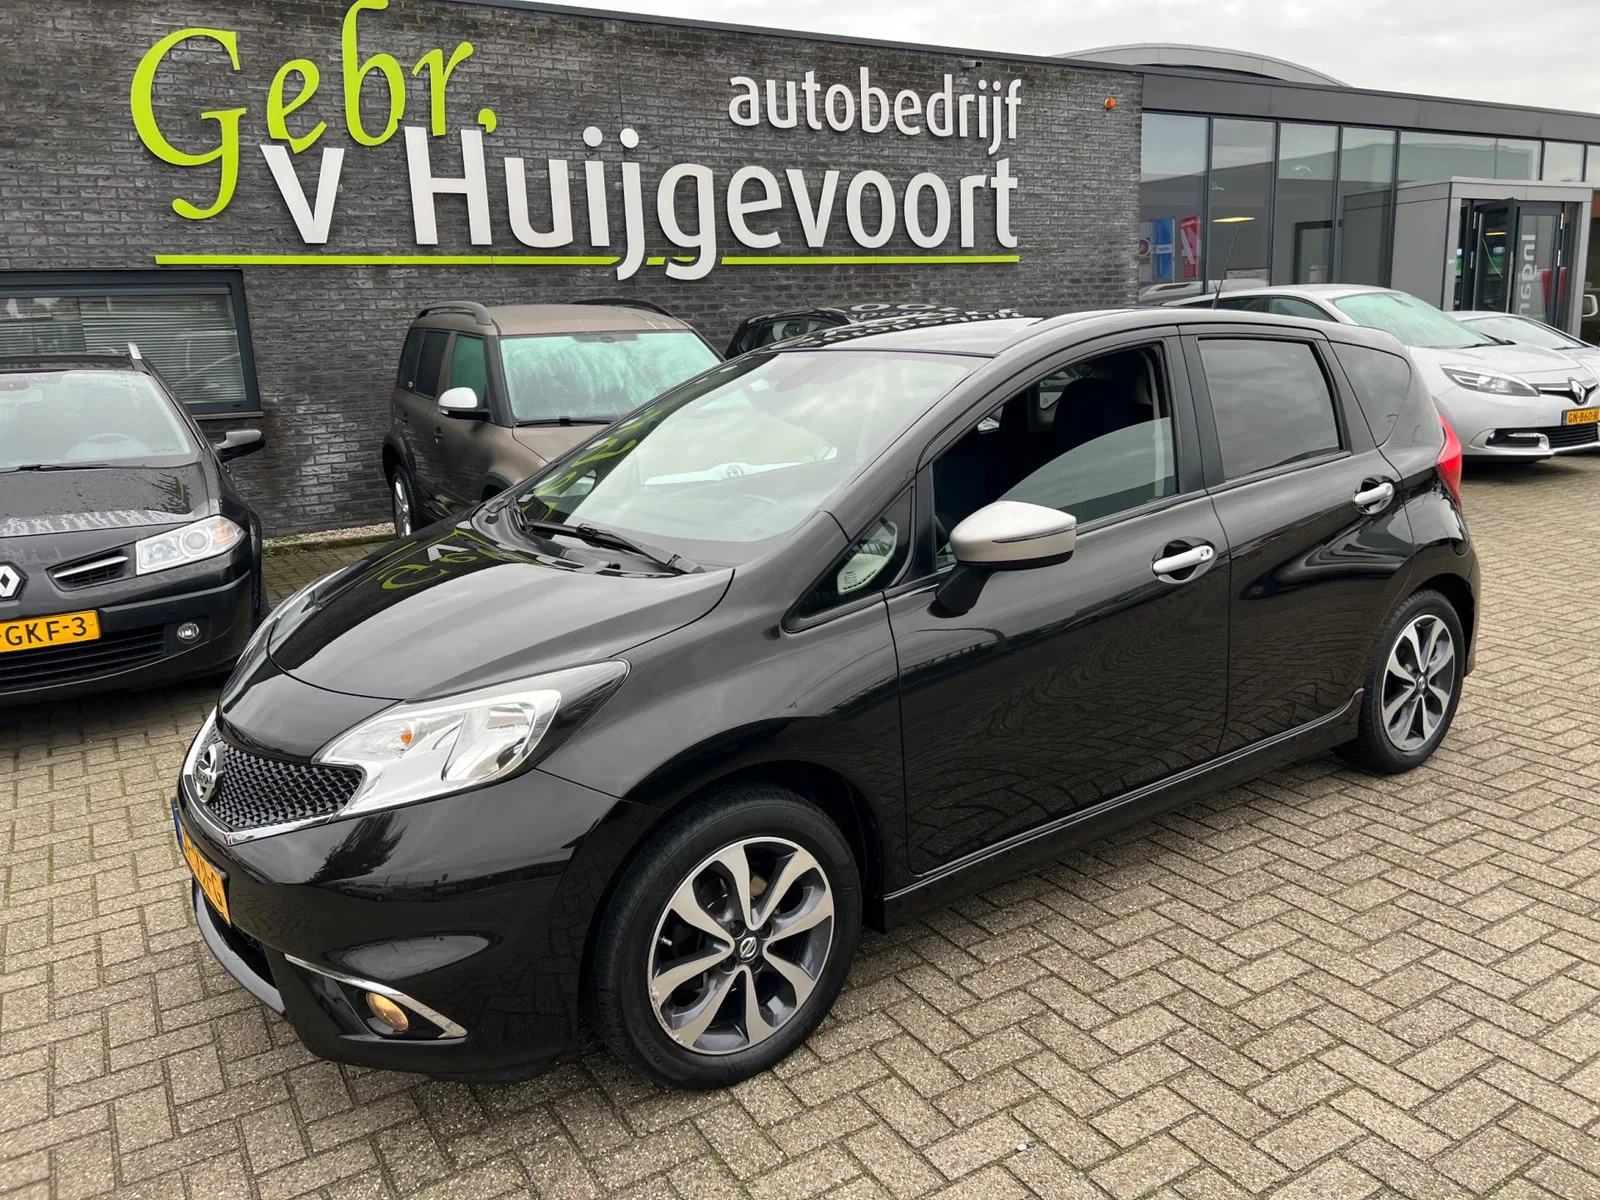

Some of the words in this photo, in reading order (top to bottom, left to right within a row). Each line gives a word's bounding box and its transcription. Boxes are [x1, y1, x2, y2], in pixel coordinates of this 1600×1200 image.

[130, 0, 497, 220] Gebr.
[728, 66, 1022, 155] autobedrijf
[260, 144, 345, 244] v
[404, 125, 1019, 281] Huijgevoort
[0, 616, 87, 646] GKF-3
